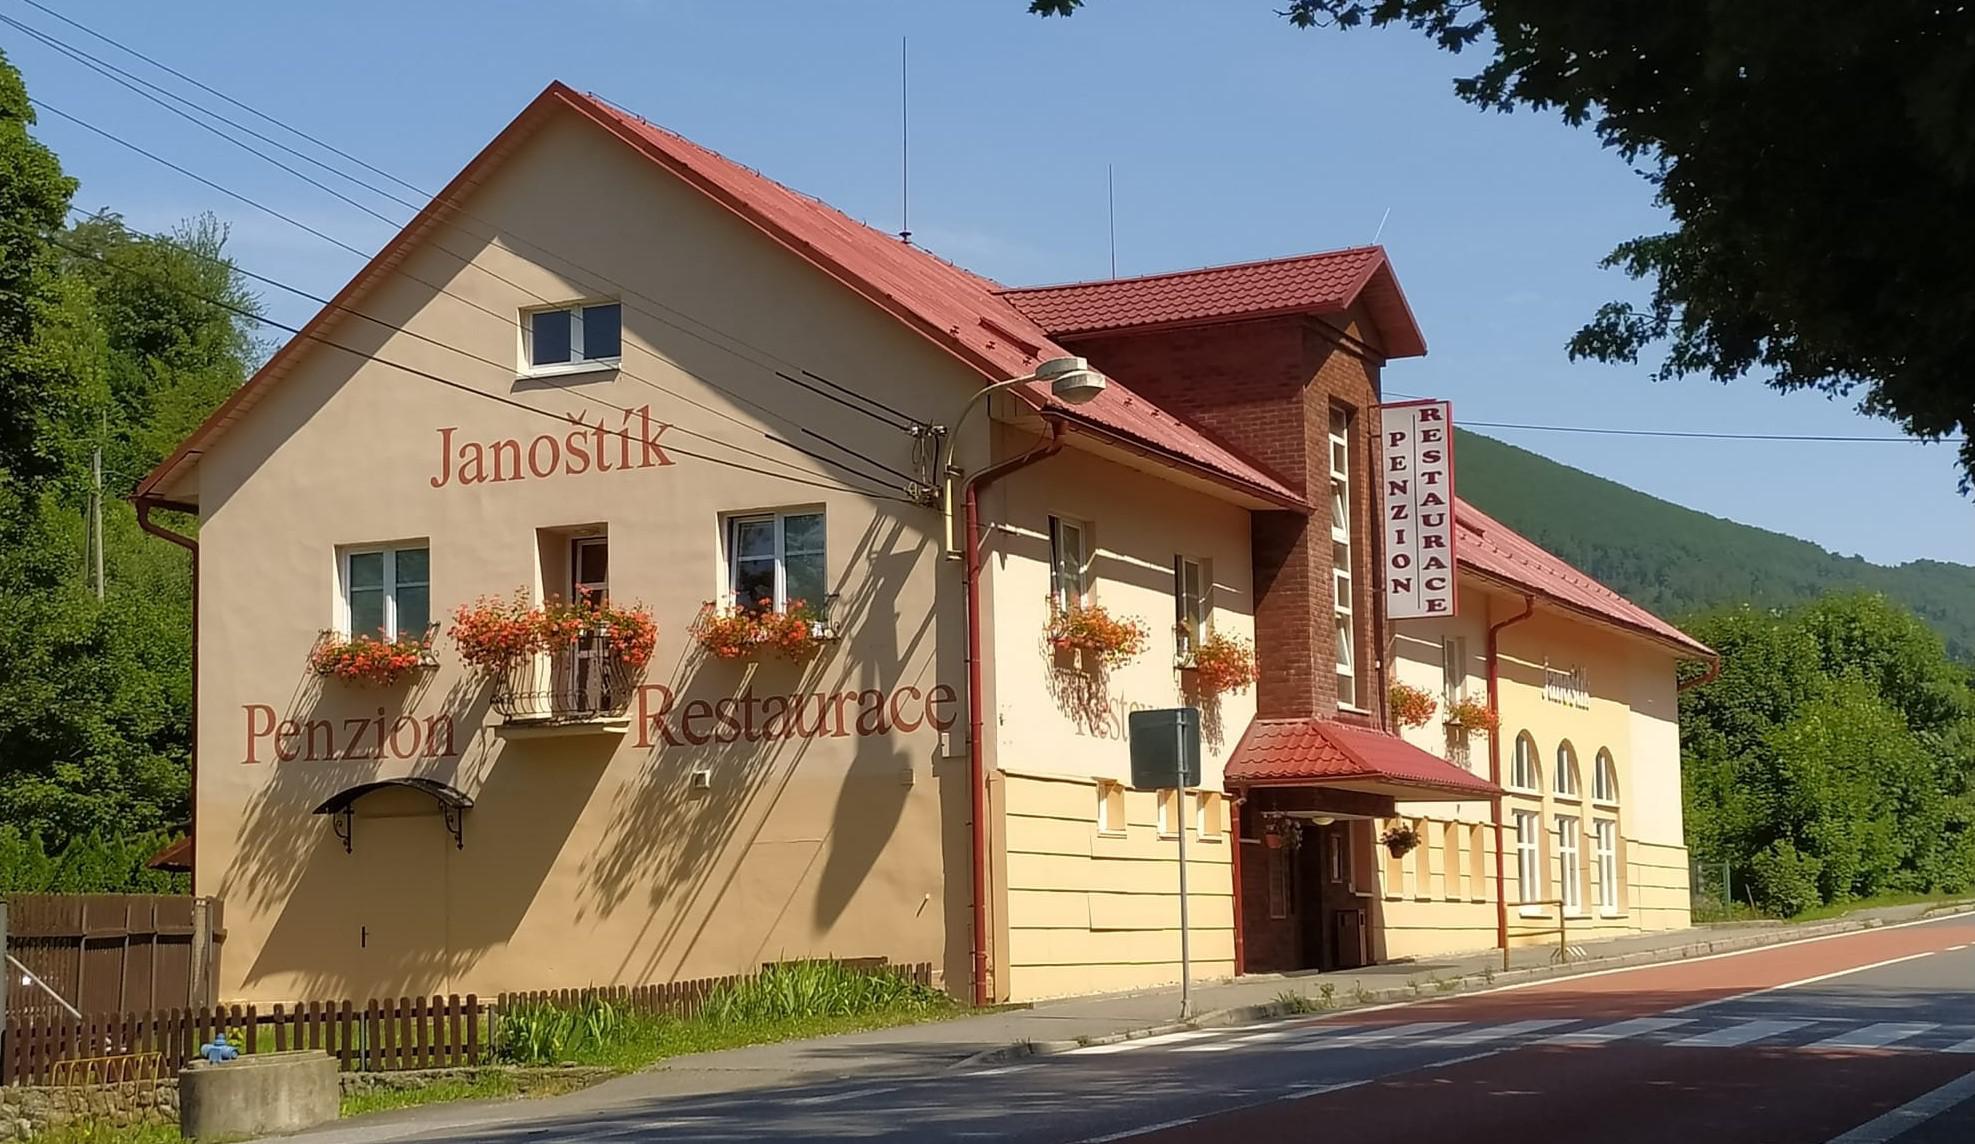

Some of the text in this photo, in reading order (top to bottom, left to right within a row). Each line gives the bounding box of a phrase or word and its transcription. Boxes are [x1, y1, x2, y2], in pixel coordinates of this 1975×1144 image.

[430, 404, 676, 489] Janoštík
[1388, 431, 1413, 595] PENZION
[1418, 408, 1448, 613] RESTAURACE
[241, 684, 958, 764] Penzion Restaurace
